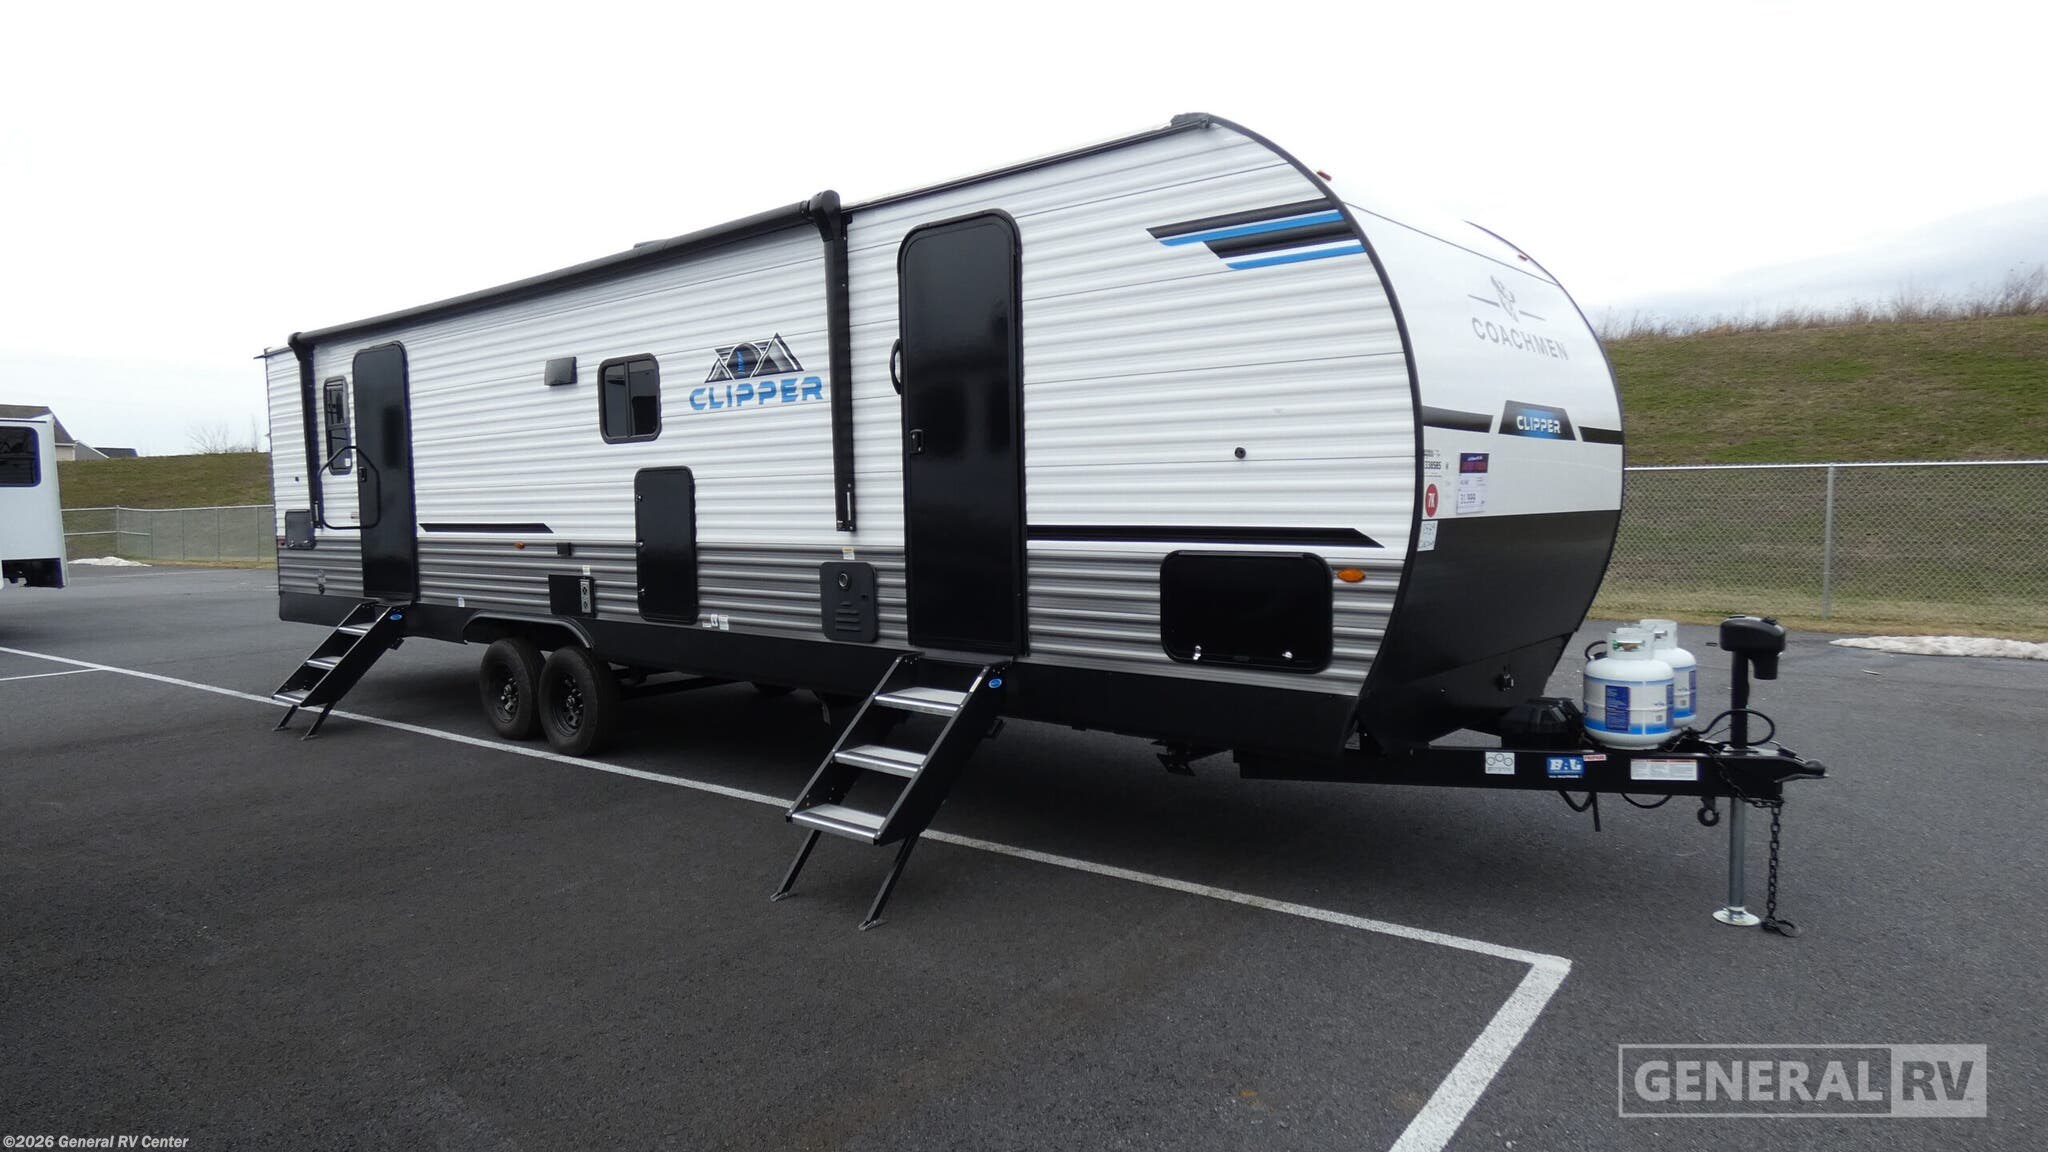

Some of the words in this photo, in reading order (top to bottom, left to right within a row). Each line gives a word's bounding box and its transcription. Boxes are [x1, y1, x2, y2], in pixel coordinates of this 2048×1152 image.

[1472, 317, 1568, 360] COACHMEN
[689, 376, 823, 410] CLIPPER
[1516, 415, 1561, 434] CLIPPER
